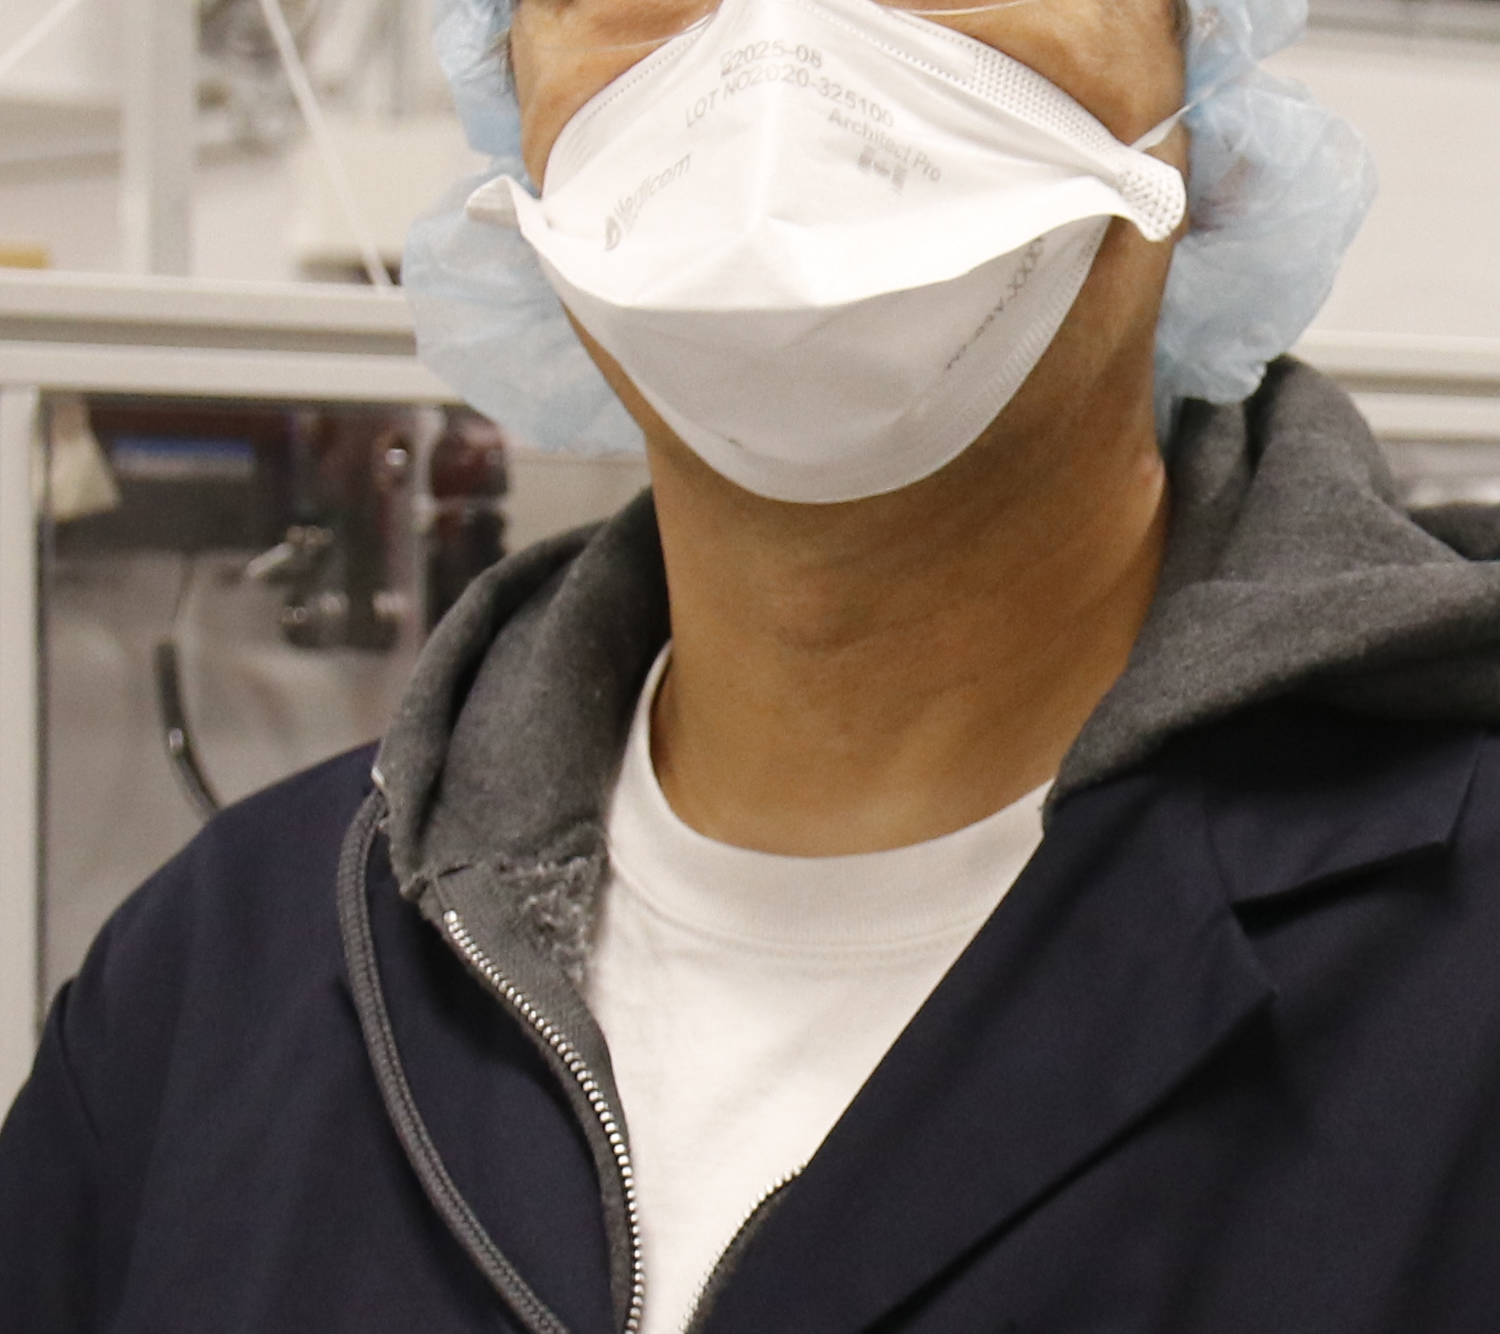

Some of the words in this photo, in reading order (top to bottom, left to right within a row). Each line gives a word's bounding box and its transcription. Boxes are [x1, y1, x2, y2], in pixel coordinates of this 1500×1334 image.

[732, 40, 823, 69] 2025-08
[685, 87, 719, 129] LOT
[912, 149, 941, 182] Pro
